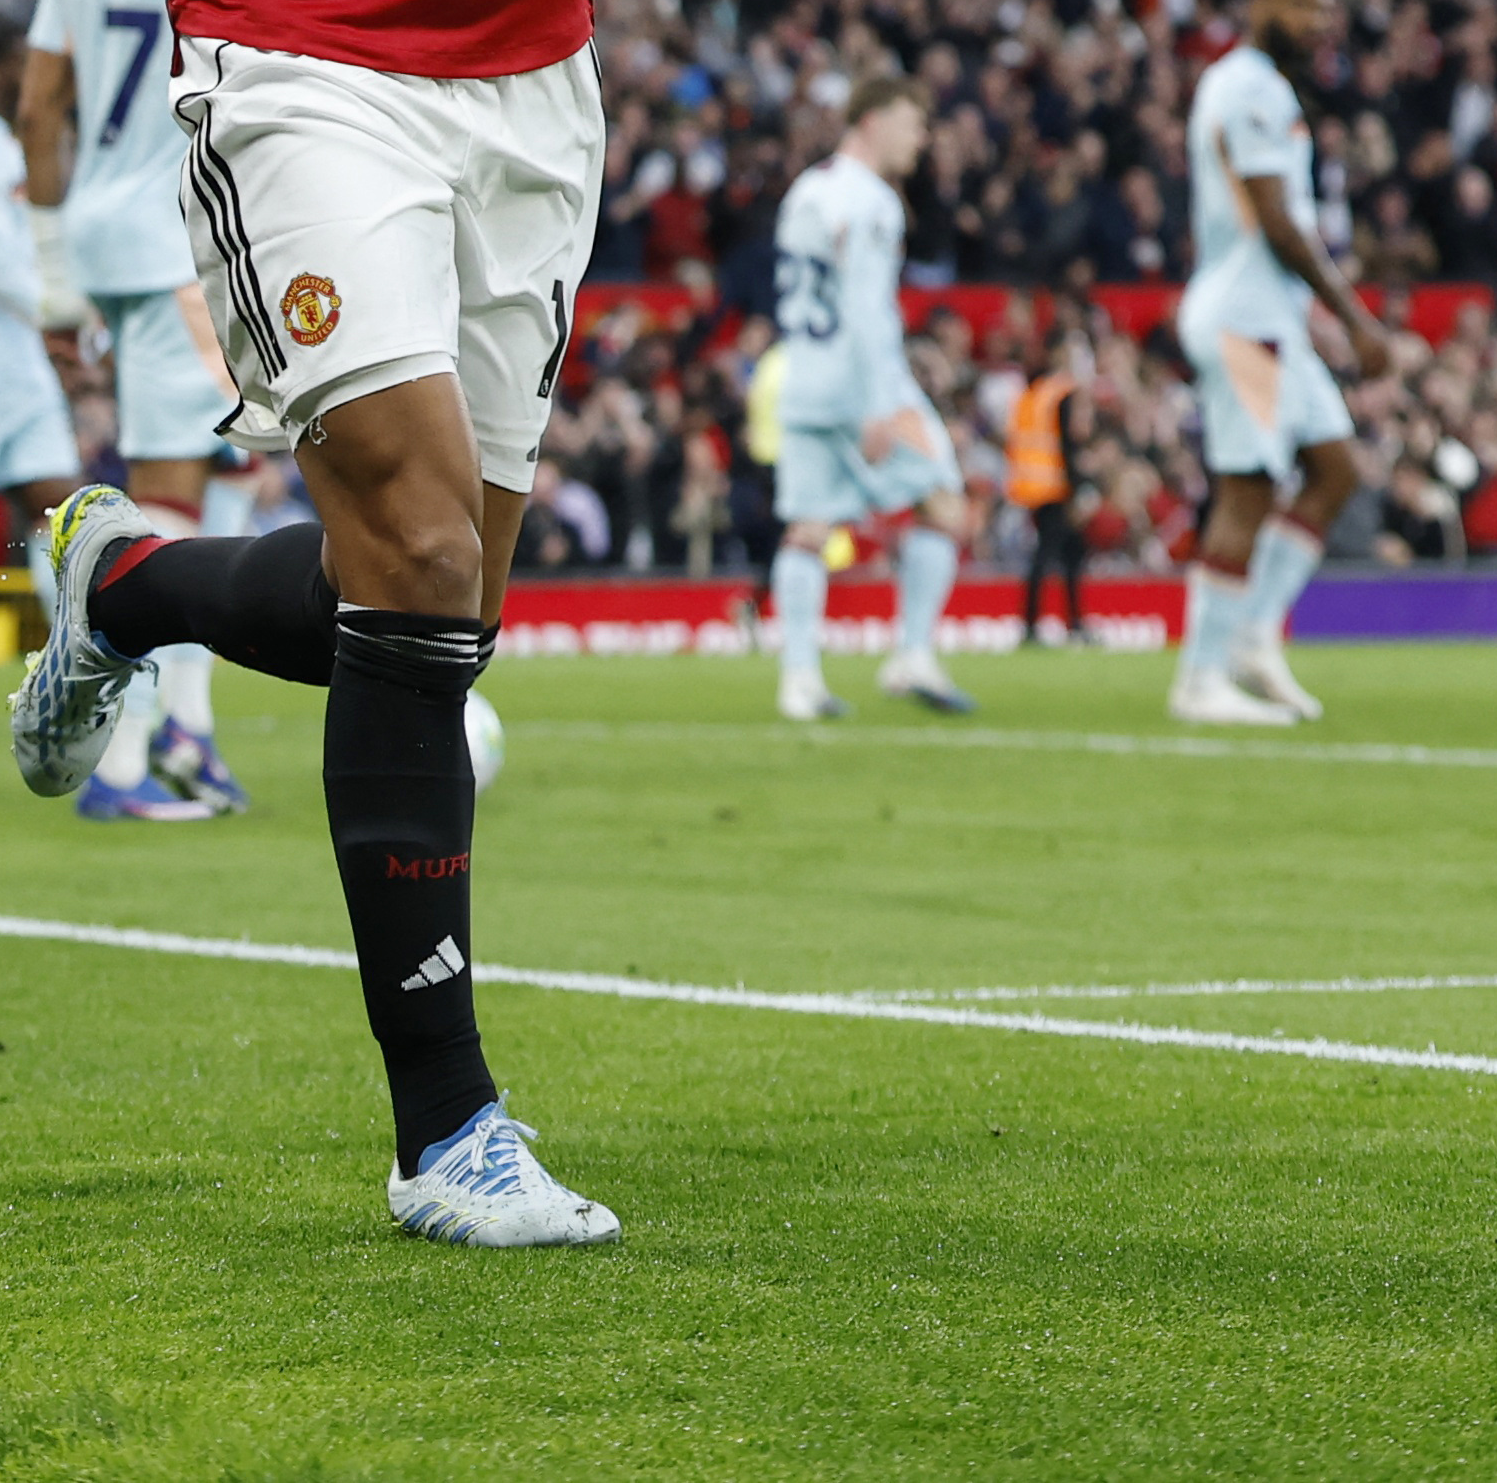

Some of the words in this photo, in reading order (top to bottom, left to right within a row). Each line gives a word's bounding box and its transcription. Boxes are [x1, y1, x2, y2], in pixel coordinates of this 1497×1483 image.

[100, 9, 161, 146] 7
[285, 278, 331, 312] MANCHESTER
[301, 321, 333, 342] UNITED
